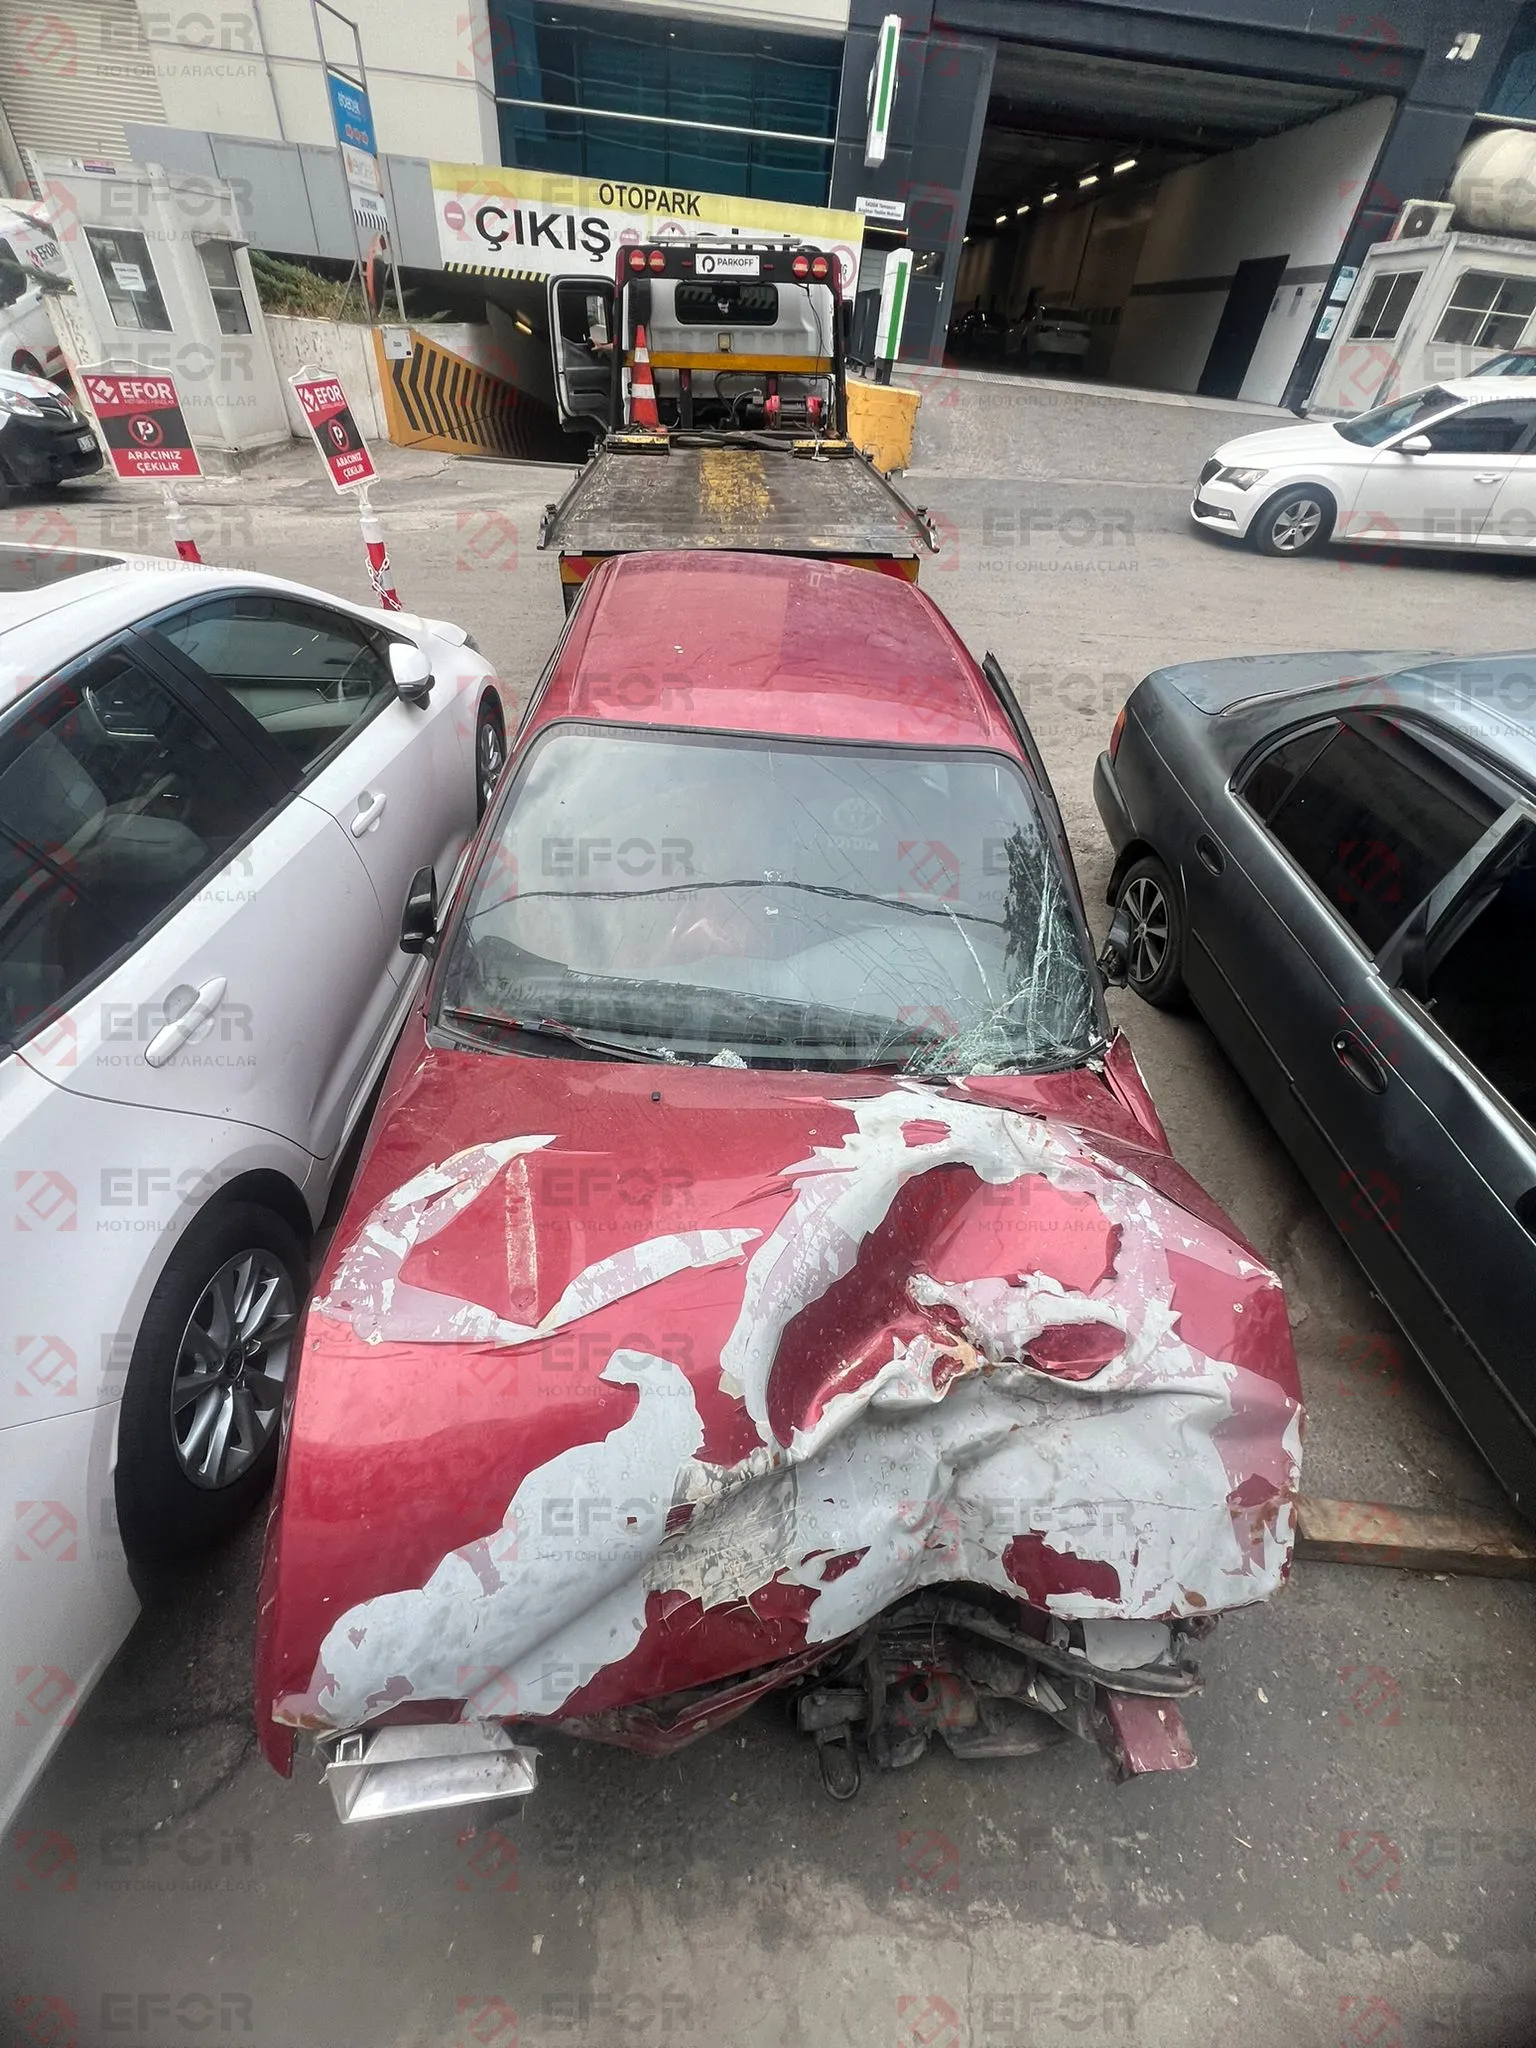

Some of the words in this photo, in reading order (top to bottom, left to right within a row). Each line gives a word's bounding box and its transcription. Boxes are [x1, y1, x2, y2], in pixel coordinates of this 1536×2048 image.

[600, 182, 701, 217] OTOPARK
[475, 205, 611, 263] ÇIKIŞ
[37, 242, 59, 260] EFOR
[717, 257, 754, 267] PARKOFF
[118, 381, 174, 400] EFOR
[314, 384, 343, 405] EFOR
[128, 450, 182, 461] ARACINIZ
[335, 451, 363, 468] ARACINIZ
[136, 461, 180, 474] ÇEKİLİR
[342, 464, 365, 480] ÇEKİLİR
